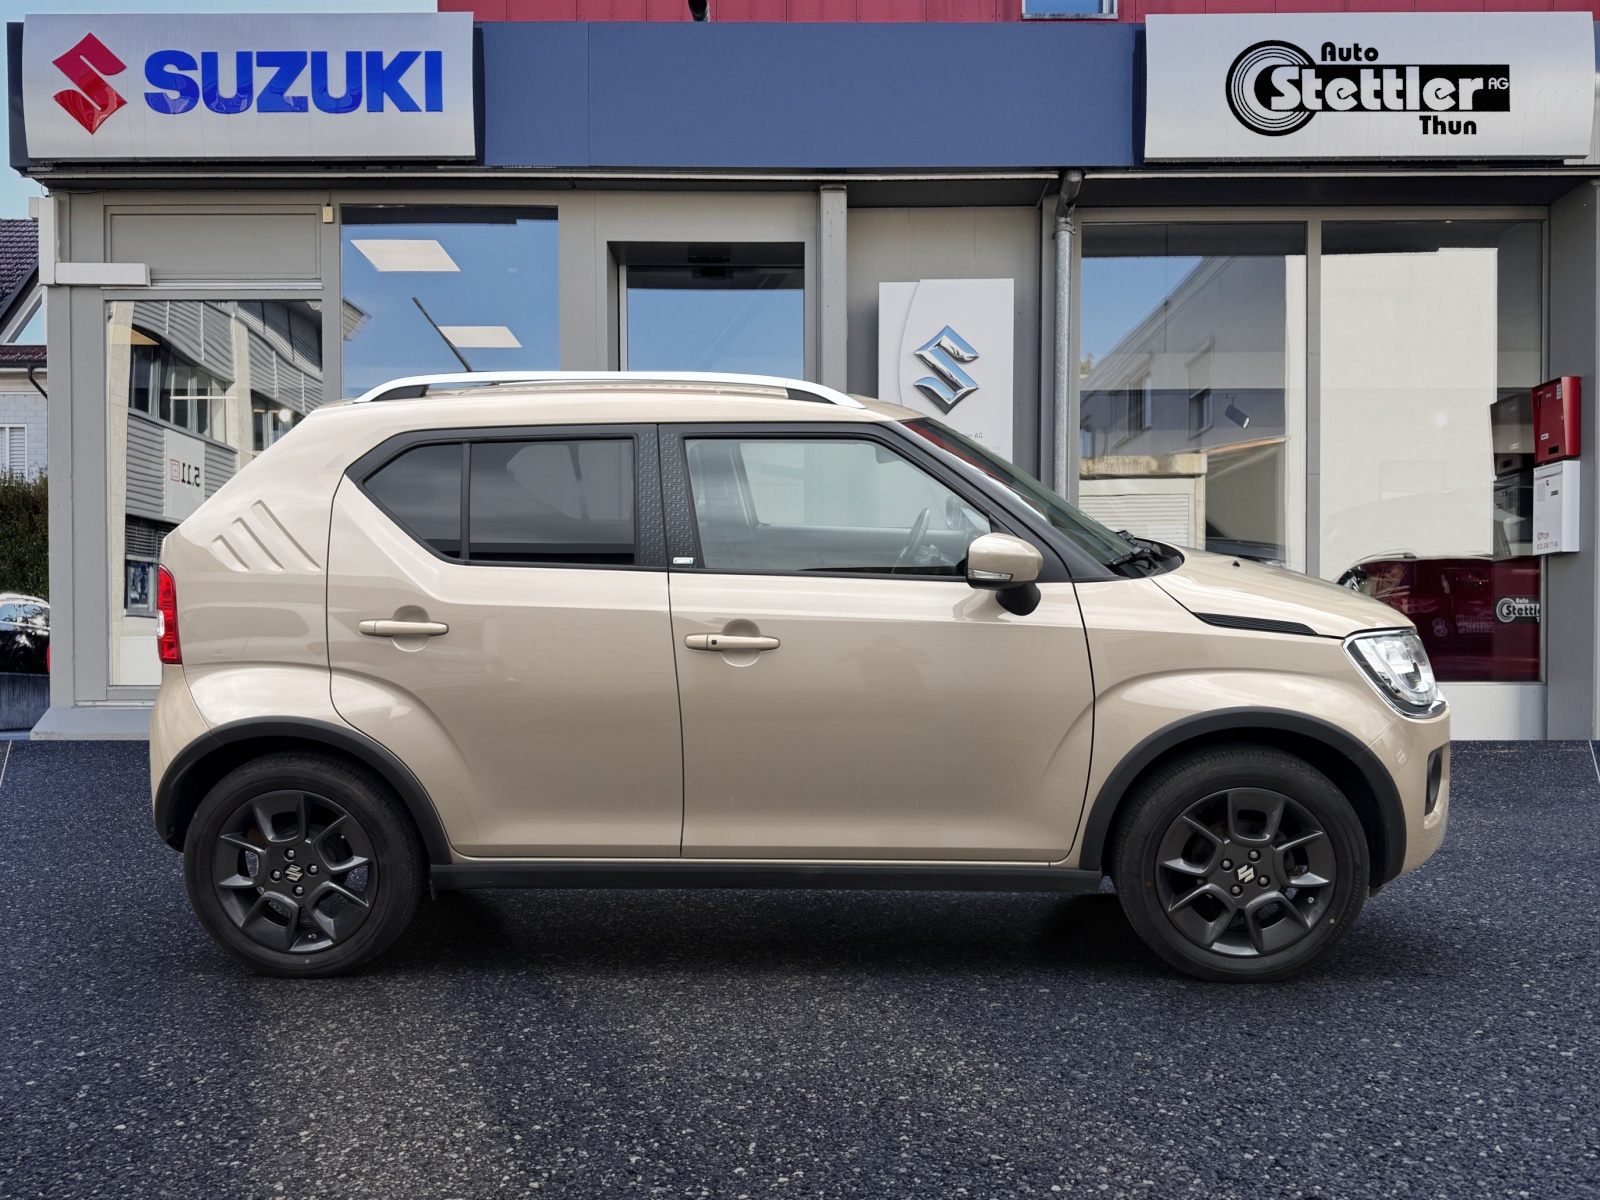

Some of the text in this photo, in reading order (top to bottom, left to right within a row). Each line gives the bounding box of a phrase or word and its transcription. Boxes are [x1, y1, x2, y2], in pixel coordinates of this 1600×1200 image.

[1321, 41, 1379, 62] Auto
[144, 50, 443, 114] SUZUKI
[1271, 66, 1509, 111] Stettler AG
[1419, 115, 1477, 135] Thun
